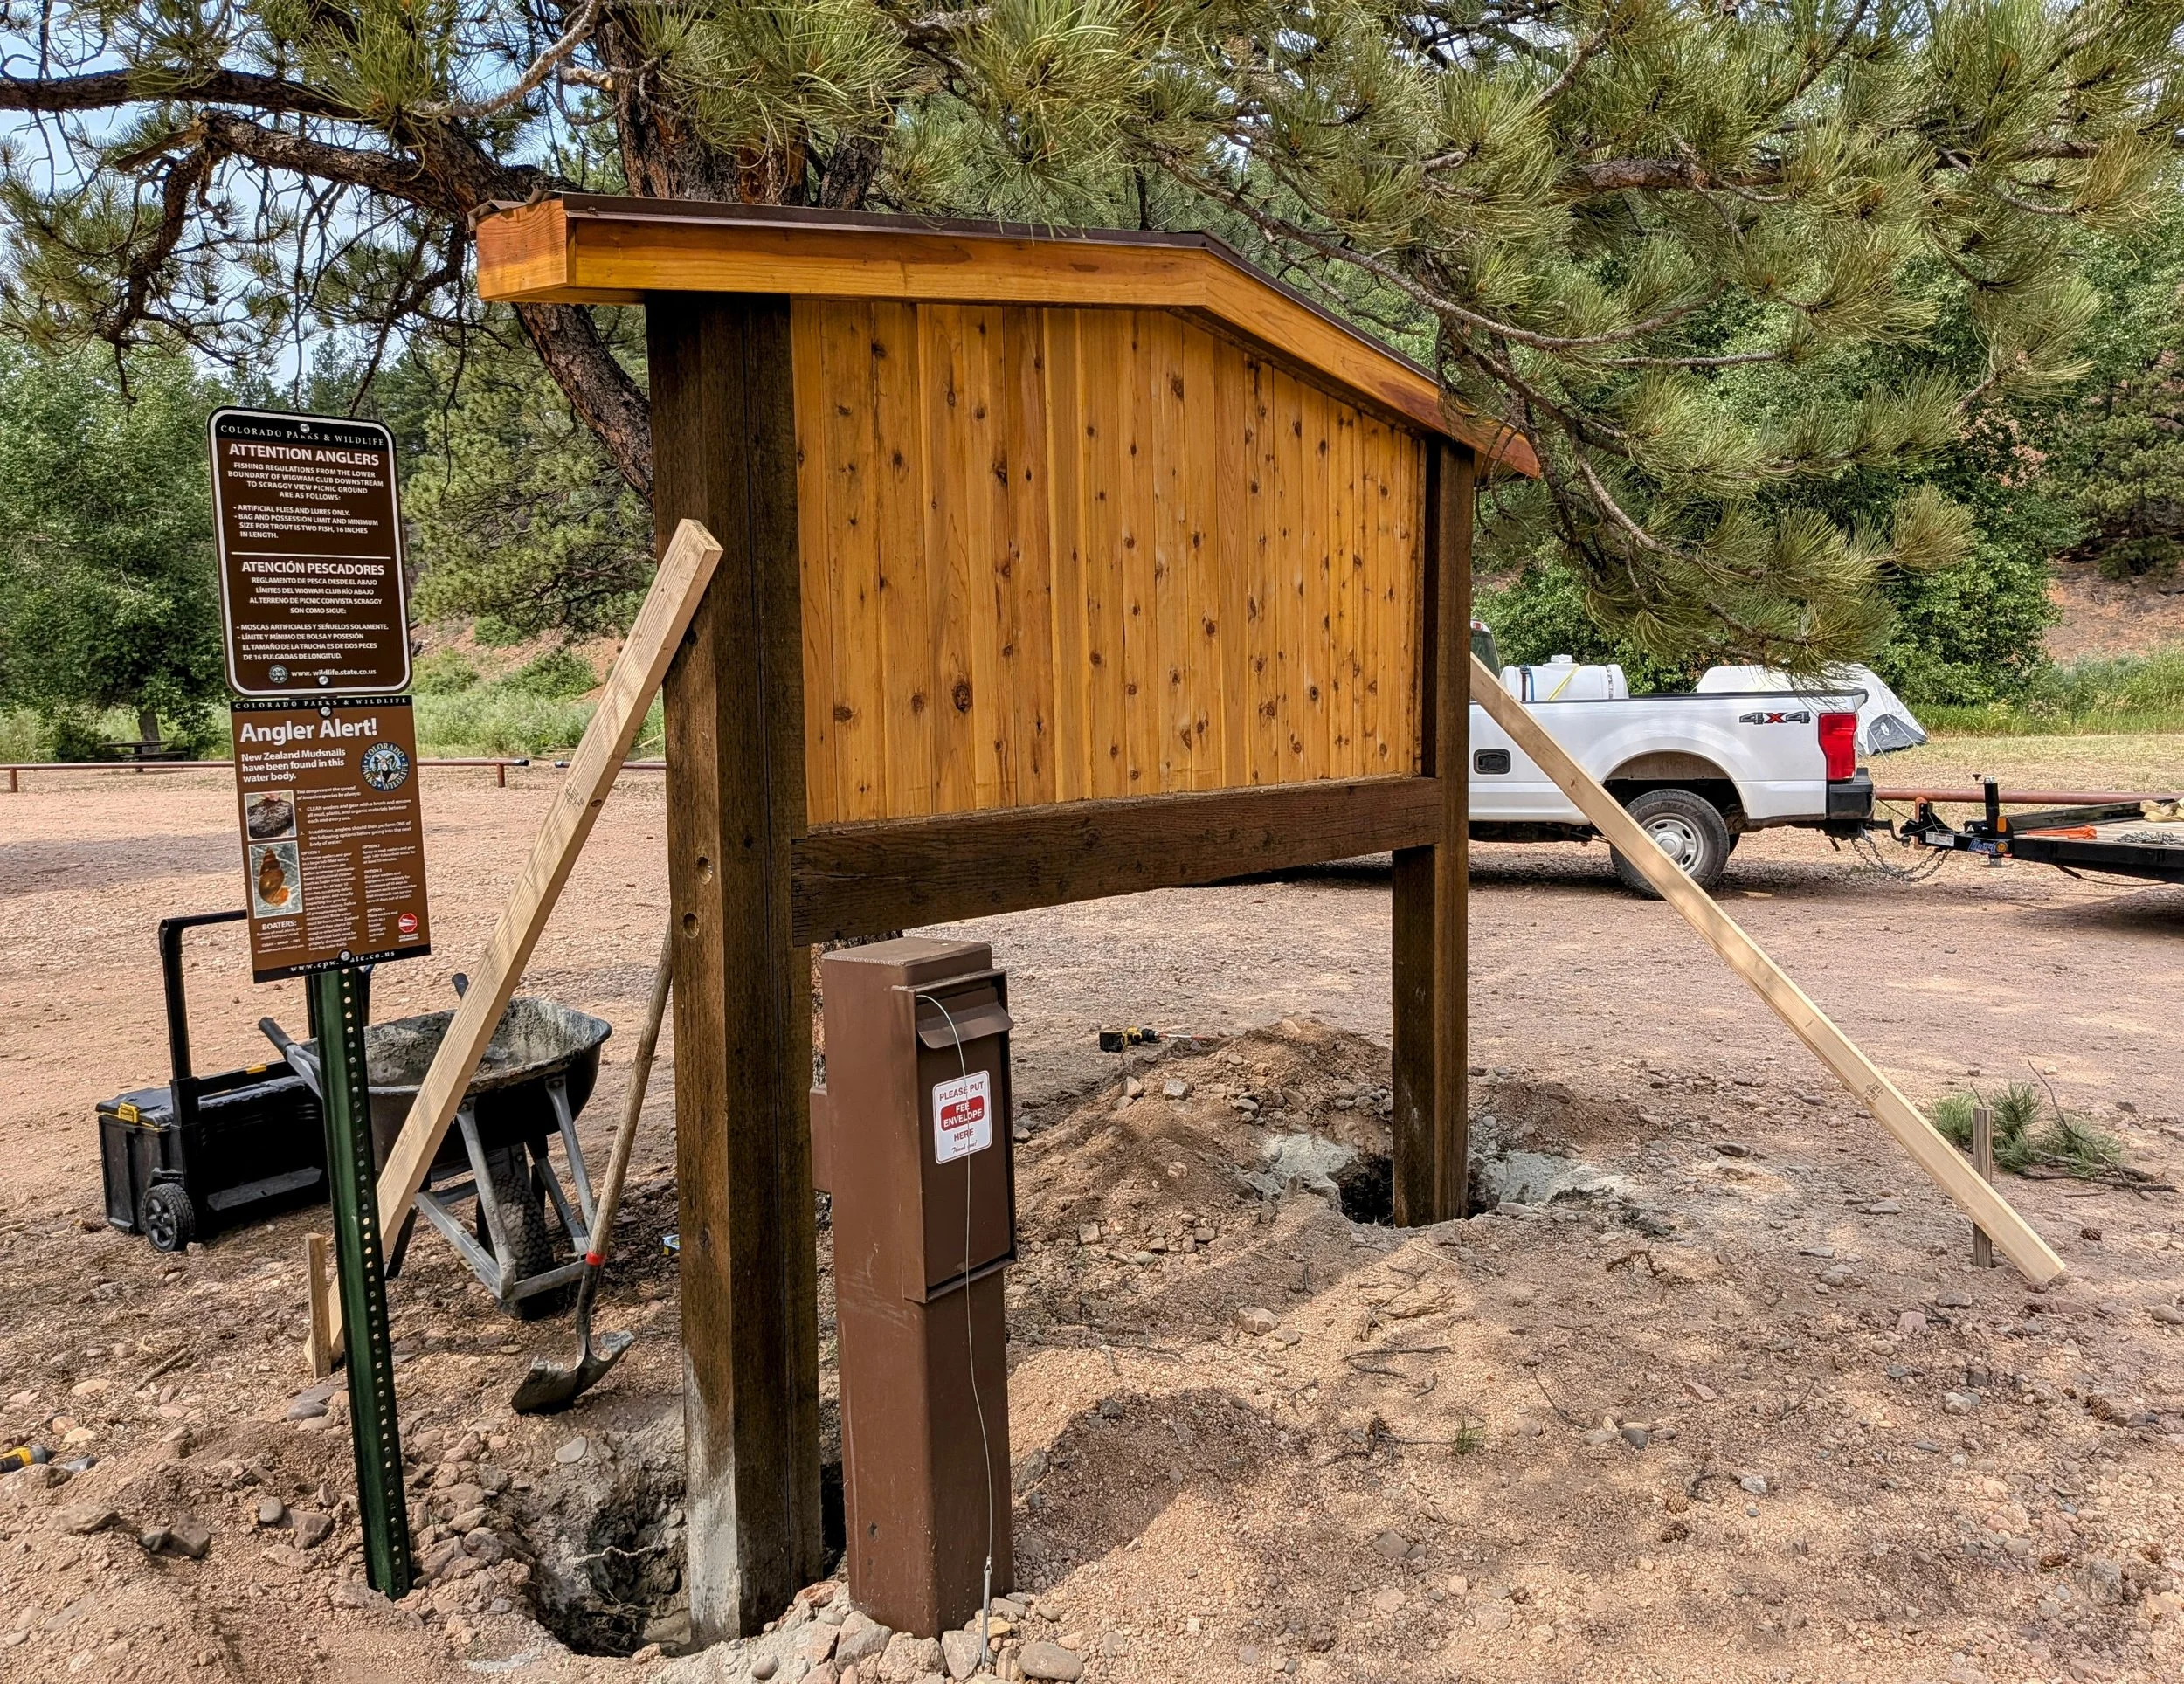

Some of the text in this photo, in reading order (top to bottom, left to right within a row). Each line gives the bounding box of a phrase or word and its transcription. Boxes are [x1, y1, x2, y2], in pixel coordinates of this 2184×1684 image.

[220, 425, 282, 438] COLORADO
[335, 435, 384, 445] WILDLIFE
[230, 444, 379, 465] ATTENTION ANGLERS
[266, 465, 314, 473] REGULATIONS
[242, 560, 384, 575] ATENCIÓN PESCADORES
[239, 718, 377, 745] Angler Alert!
[241, 749, 346, 761] New Zealand Mudsnails
[364, 743, 404, 759] COLORADO
[242, 763, 265, 772] have
[266, 762, 289, 770] been
[290, 761, 317, 770] found
[328, 759, 344, 767] this
[243, 772, 296, 783] water body.
[362, 762, 408, 790] PARKS WILDLIFE
[262, 920, 297, 930] BOATERS:
[940, 1081, 984, 1101] PLEASE PUT
[956, 1102, 970, 1113] FEE
[943, 1108, 982, 1127] ENVELOPE
[954, 1128, 974, 1142] HERE
